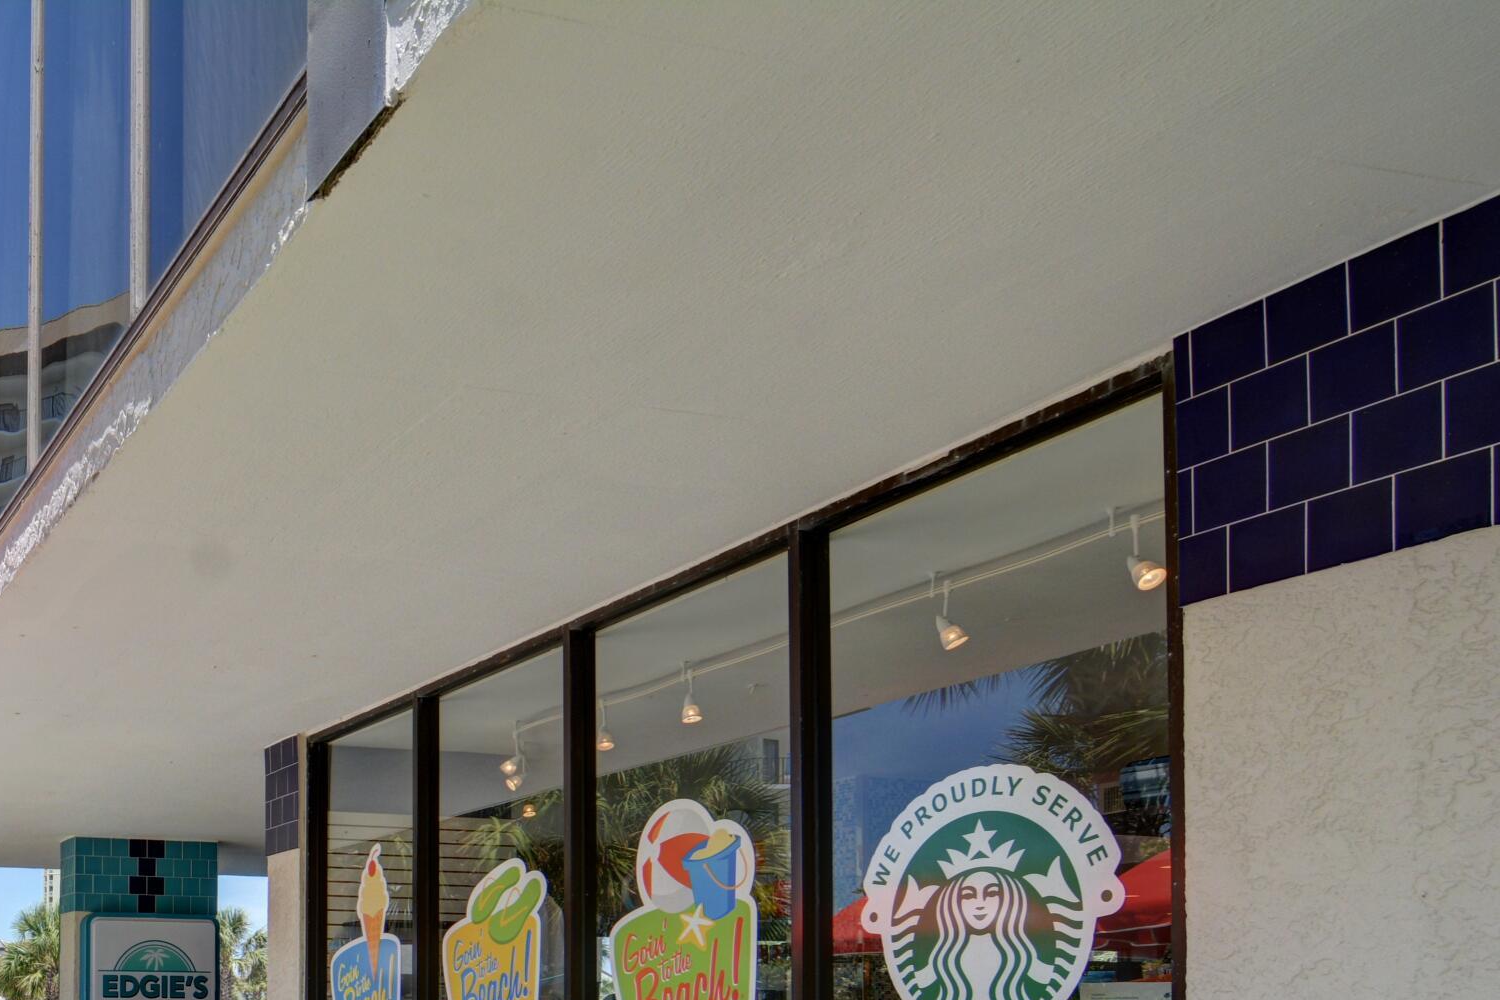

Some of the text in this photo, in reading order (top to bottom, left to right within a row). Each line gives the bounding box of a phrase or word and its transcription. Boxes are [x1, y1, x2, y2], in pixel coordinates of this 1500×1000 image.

[872, 775, 1109, 887] WE PROUDLY SERVE
[657, 944, 692, 982] to the
[102, 974, 209, 999] EDGIE'S
